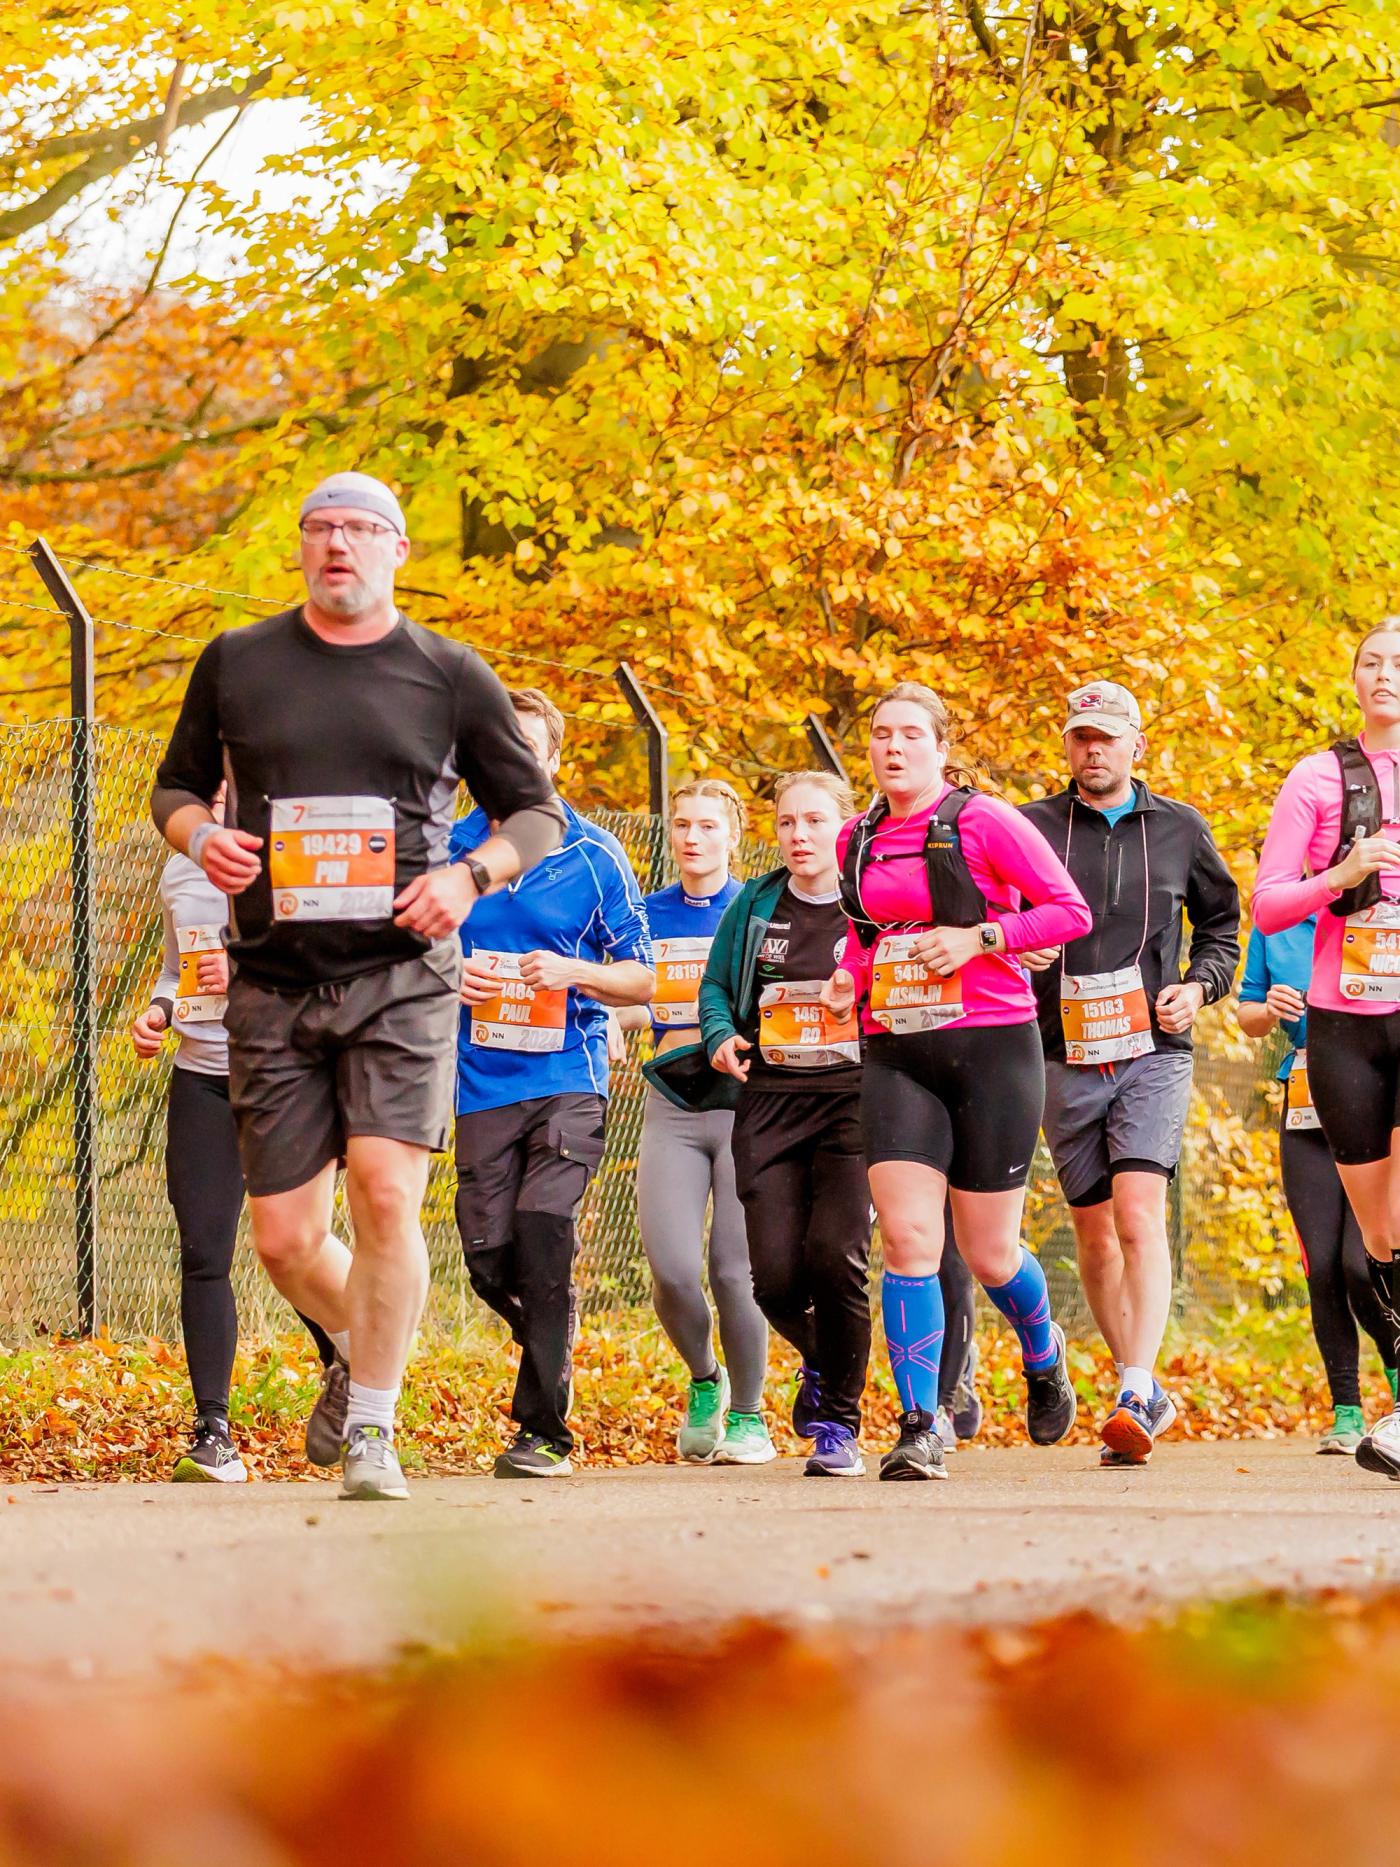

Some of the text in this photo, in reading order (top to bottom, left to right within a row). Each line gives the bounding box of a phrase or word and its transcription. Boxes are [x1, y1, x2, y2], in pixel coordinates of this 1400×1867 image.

[302, 833, 362, 856] 19429
[314, 860, 351, 884] PIN
[666, 963, 705, 981] 28191
[885, 984, 943, 1007] JASMIJN
[1368, 985, 1383, 993] NN
[498, 1003, 532, 1023] PAUL
[1082, 998, 1124, 1019] 15183
[492, 1032, 505, 1040] NN
[800, 1027, 821, 1044] BO
[1082, 1015, 1132, 1039] THOMAS
[519, 1029, 559, 1049] 2024
